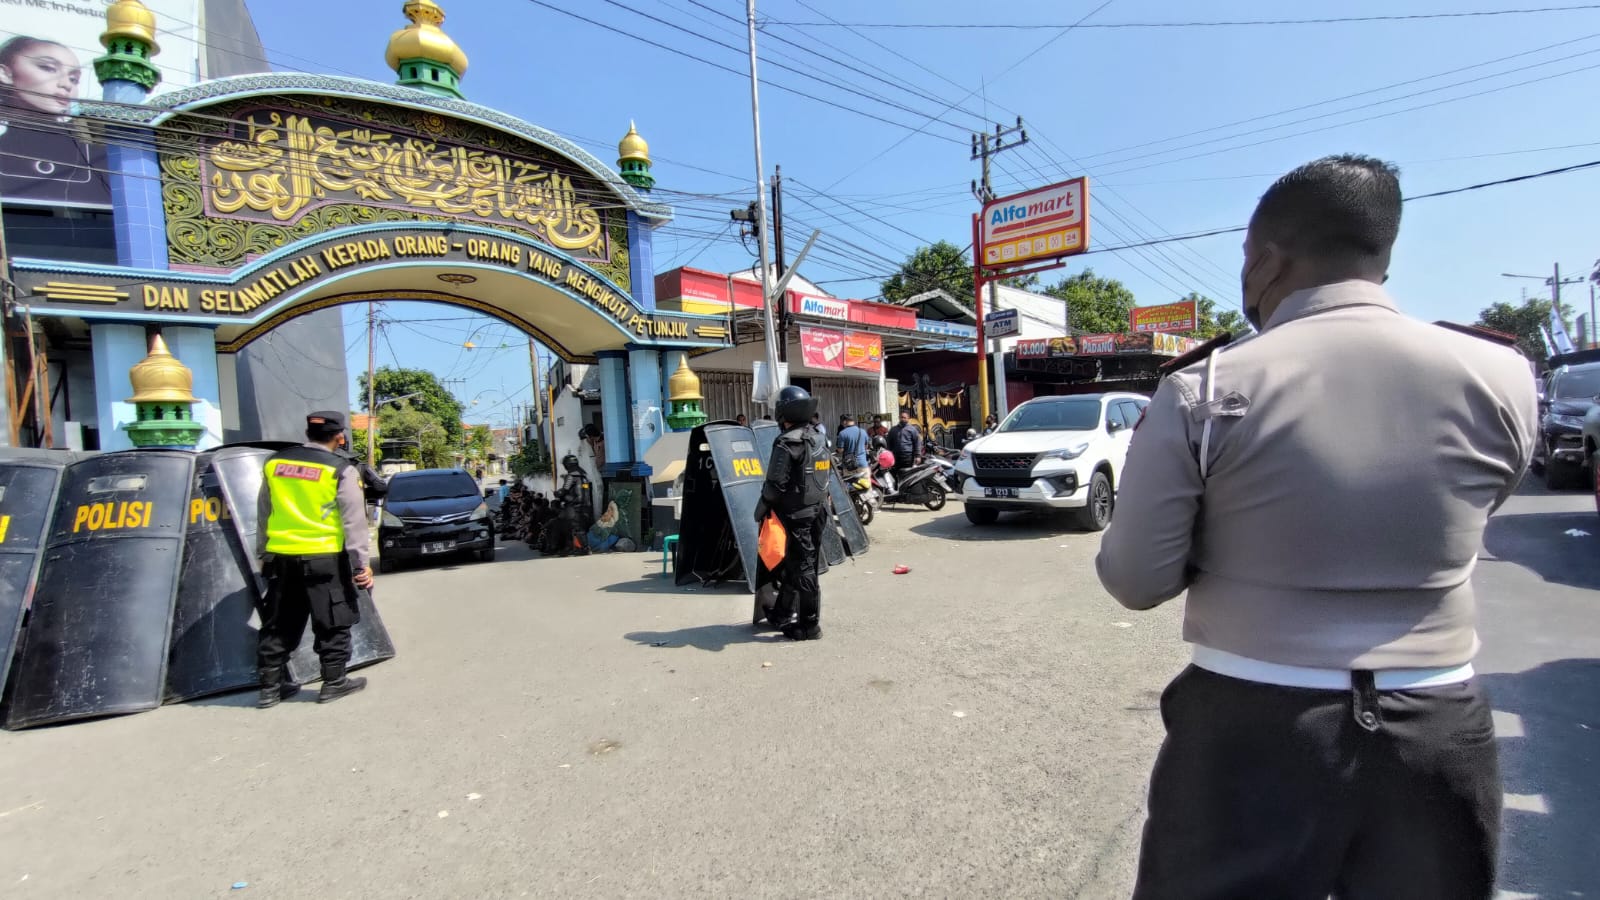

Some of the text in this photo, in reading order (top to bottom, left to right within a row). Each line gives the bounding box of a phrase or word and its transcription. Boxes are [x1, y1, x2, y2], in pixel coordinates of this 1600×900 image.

[991, 191, 1073, 225] Alfamart
[143, 284, 189, 309] DAN
[200, 255, 322, 312] SELAMATLAH
[321, 237, 391, 270] KEPADA
[394, 235, 448, 256] ORANG
[467, 237, 520, 264] ORANG
[528, 250, 561, 278] YANG
[566, 270, 629, 321] MENGIKUTI
[628, 314, 688, 337] PETUNJUK
[804, 299, 845, 318] Alfamart
[992, 319, 1011, 328] ATM
[1019, 342, 1045, 355] 13.000
[1082, 337, 1113, 354] PADANG
[276, 464, 322, 480] POLISI
[73, 502, 152, 534] POLISI
